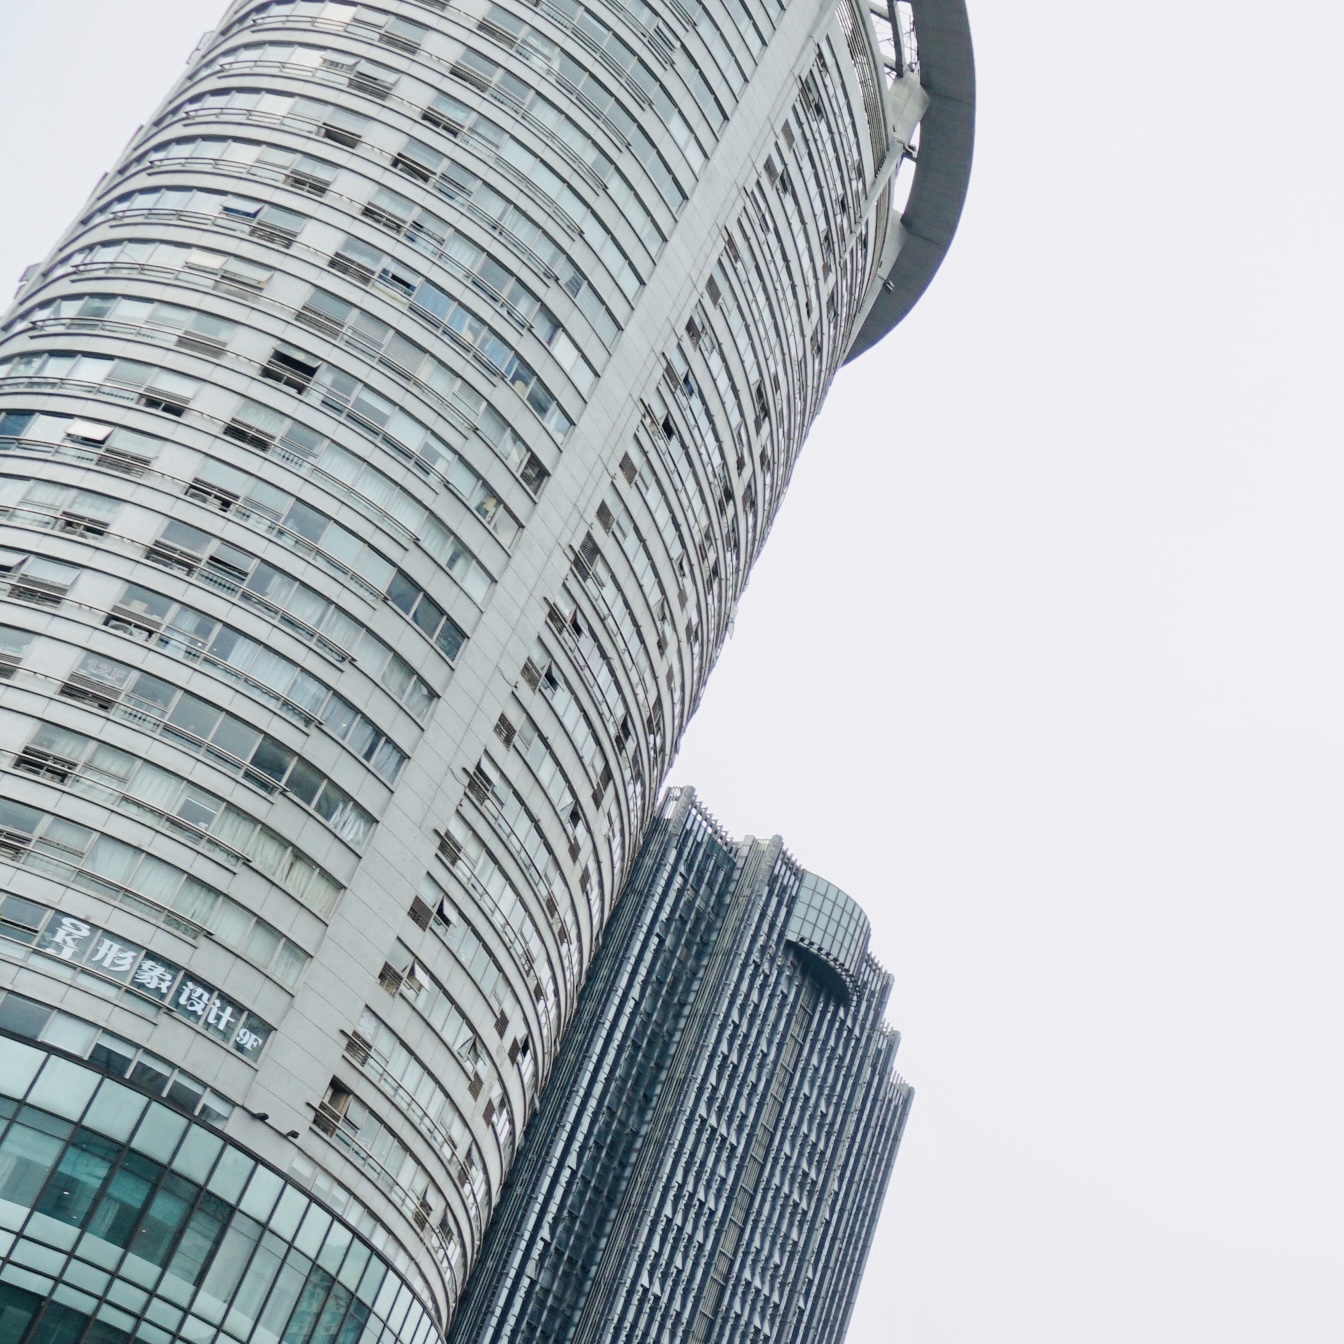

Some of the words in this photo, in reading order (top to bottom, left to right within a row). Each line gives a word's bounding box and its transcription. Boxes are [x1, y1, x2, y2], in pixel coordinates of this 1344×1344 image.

[92, 938, 235, 1031] 形象设计
[236, 1028, 263, 1051] 9F
